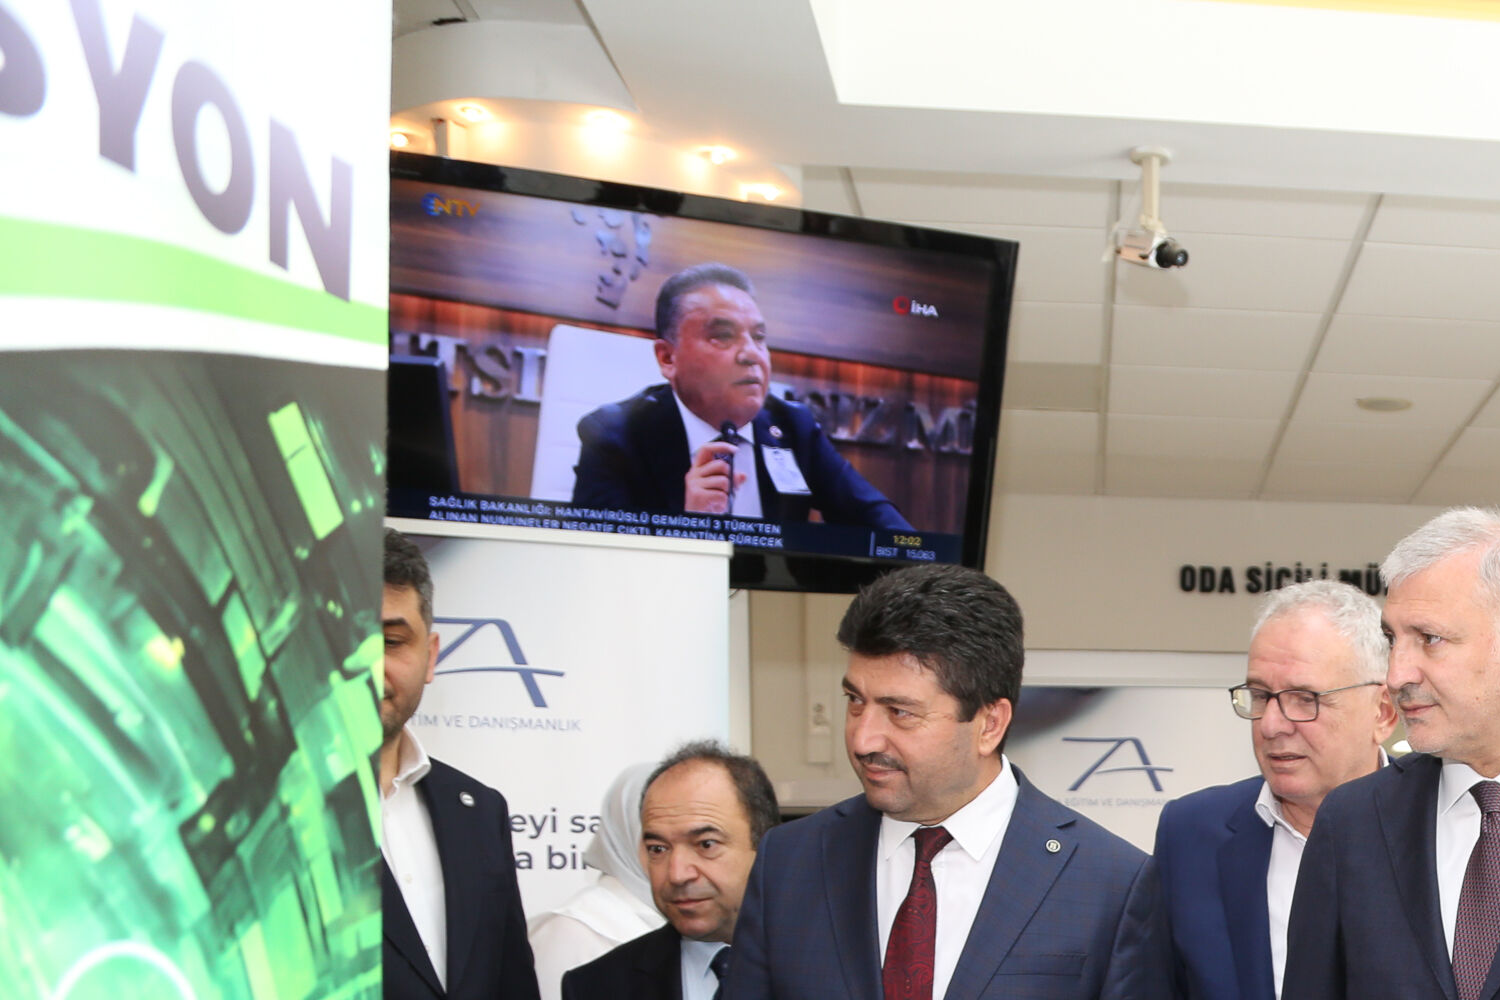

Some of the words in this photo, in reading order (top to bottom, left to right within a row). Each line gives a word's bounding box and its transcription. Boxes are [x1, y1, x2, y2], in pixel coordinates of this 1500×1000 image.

[434, 197, 480, 217] NTV
[910, 300, 938, 317] İHA
[429, 495, 477, 510] SAĞLIK
[713, 519, 722, 530] 3
[728, 533, 783, 548] SÜRECEK
[893, 535, 922, 546] 12:02
[1179, 564, 1235, 594] ODA
[443, 715, 463, 728] VE
